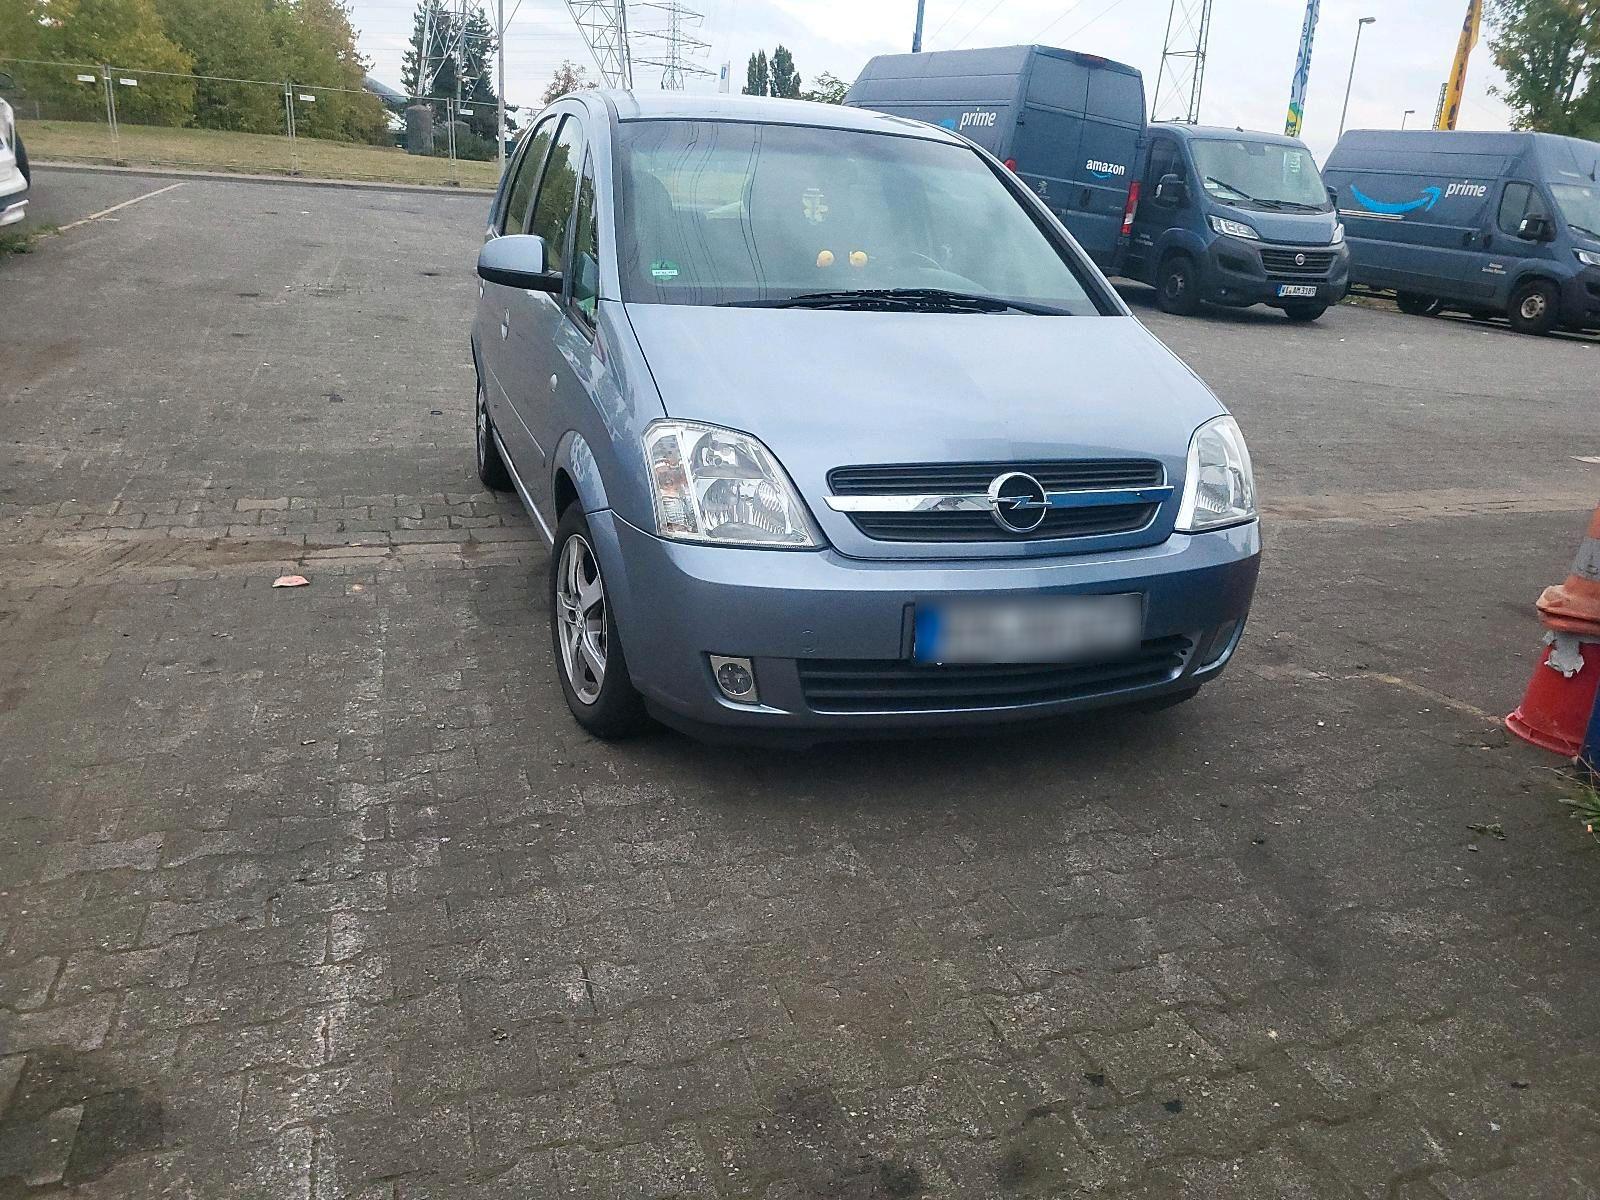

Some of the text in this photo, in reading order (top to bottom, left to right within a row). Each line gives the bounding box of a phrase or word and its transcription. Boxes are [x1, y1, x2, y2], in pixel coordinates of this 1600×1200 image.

[959, 107, 997, 130] prime
[1086, 158, 1125, 176] amazon
[1444, 179, 1487, 199] prime
